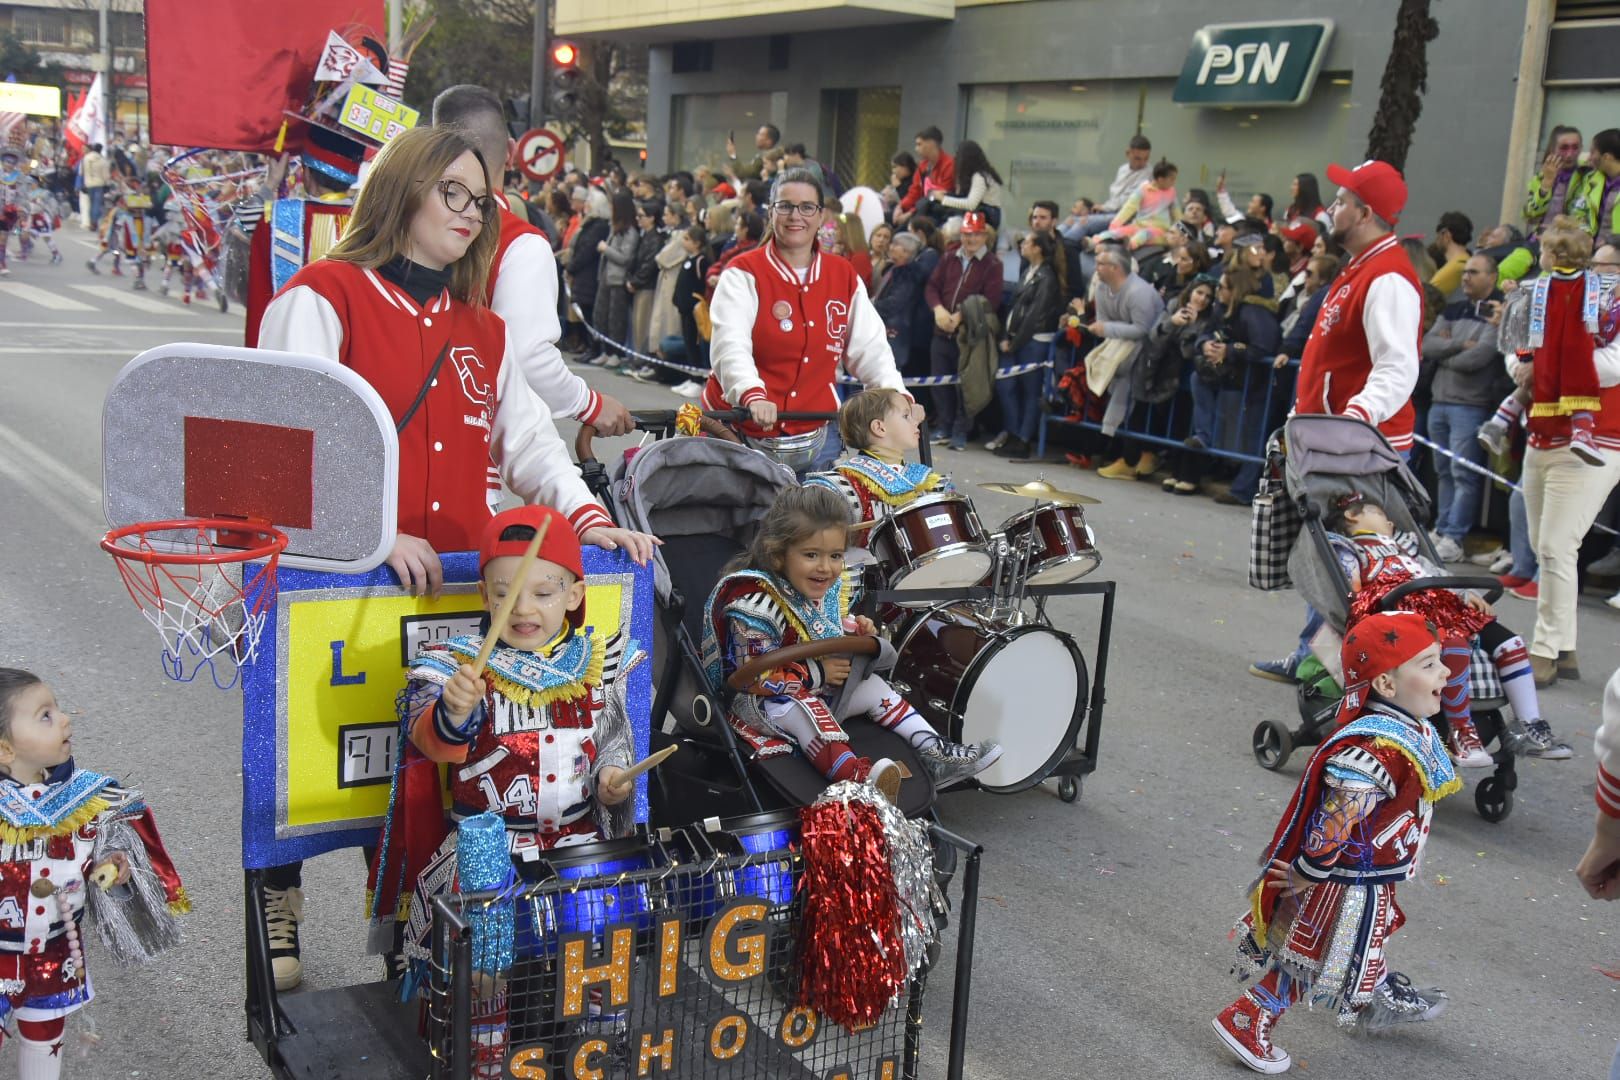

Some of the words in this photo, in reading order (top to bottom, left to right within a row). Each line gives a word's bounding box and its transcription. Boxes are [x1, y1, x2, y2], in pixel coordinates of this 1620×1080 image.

[1196, 41, 1290, 85] PSN
[449, 346, 492, 406] C
[330, 639, 367, 687] L
[347, 734, 392, 774] 91
[477, 772, 538, 817] 14
[562, 903, 768, 1017] HIG
[509, 1005, 878, 1080] SCHOO
